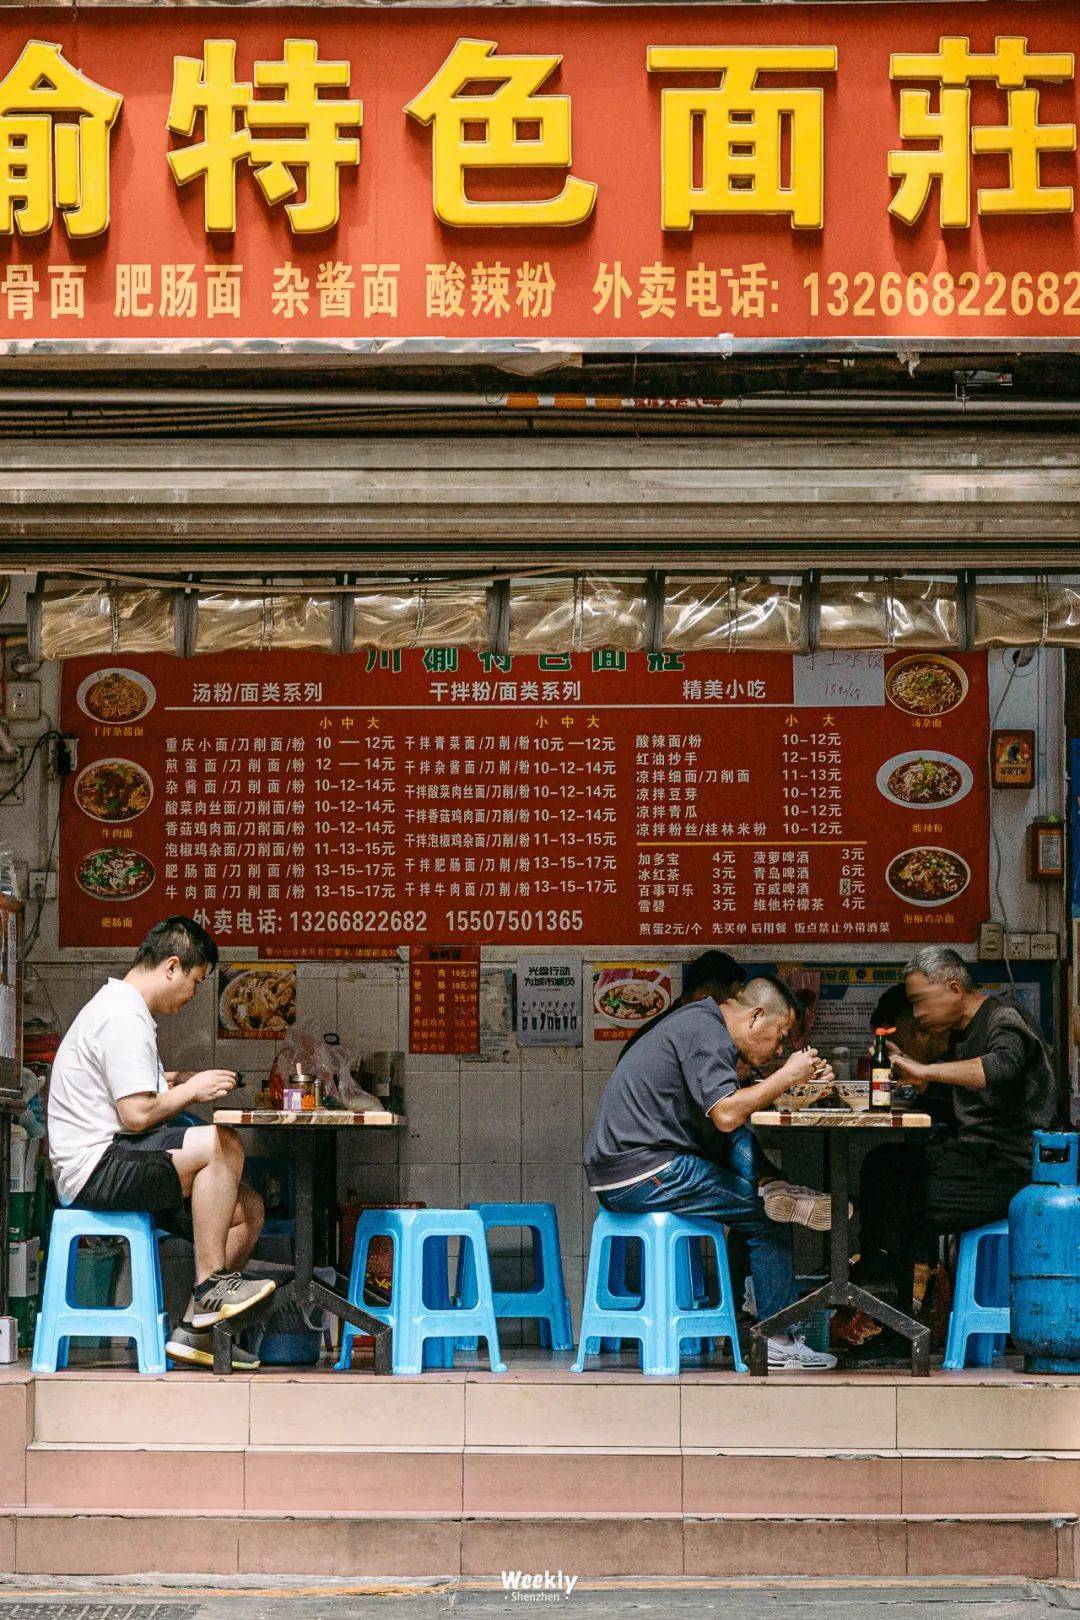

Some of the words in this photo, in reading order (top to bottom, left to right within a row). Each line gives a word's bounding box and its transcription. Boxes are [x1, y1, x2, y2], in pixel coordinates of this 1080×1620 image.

[1, 265, 86, 320] 骨面
[114, 264, 243, 318] 肥肠面
[272, 262, 400, 318] 杂酱面
[426, 262, 555, 318] 酸辣粉
[593, 261, 778, 318] 外卖电话:
[804, 272, 1080, 320] 13266822682
[193, 682, 322, 702] 汤粉/面类系列
[430, 681, 580, 701] 干拌粉/面类系列
[683, 680, 765, 699] 精美小吃
[319, 717, 332, 730] 小
[341, 716, 354, 730] 中
[367, 716, 380, 729] 大
[535, 716, 548, 729] 小
[561, 716, 574, 729] 中
[587, 714, 600, 728] 大
[785, 715, 798, 728] 小
[822, 714, 835, 727] 大
[166, 737, 304, 752] 重庆小面/刀削面/粉
[405, 736, 529, 750] 干拌青菜面/刀削/粉
[636, 735, 700, 748] 酸辣面/粉
[783, 733, 841, 745] 10-12元
[166, 758, 305, 772] 煎蛋面/刀削面/粉
[637, 752, 696, 765] 红油抄手
[783, 751, 841, 763] 12-15元
[405, 760, 529, 774] 干拌杂酱面/刀削/粉
[534, 761, 616, 774] 10-12-14元
[637, 770, 749, 783] 凉拌细面/刀削面
[783, 769, 841, 781] 11-13元
[166, 779, 304, 794] 杂酱面/刀削面/粉
[315, 779, 395, 792] 10-12-14元
[405, 784, 529, 798] 干拌酸菜肉丝面/刀削/粉
[534, 785, 616, 798] 10-12-14元
[637, 788, 697, 801] 凉拌豆芽
[783, 786, 841, 798] 10-12元
[166, 800, 304, 815] 酸菜肉丝面/刀削面/粉
[315, 800, 395, 813] 10-12-14元
[637, 805, 697, 818] 凉拌青瓜
[784, 804, 841, 816] 10-12元
[405, 809, 529, 823] 干拌香菇鸡肉面/刀削/粉
[534, 808, 616, 822] 10-12-14元
[101, 828, 134, 839] 牛肉面
[166, 821, 304, 836] 香菇鸡肉面/刀削面/粉
[315, 821, 395, 834] 10-12-14元
[637, 823, 766, 836] 凉拌粉丝/桂林米粉
[784, 822, 841, 834] 10-12元
[912, 823, 943, 833] 酸辣粉
[405, 833, 530, 848] 干拌泡椒鸡杂面/刀削/粉
[534, 832, 616, 845] 11-13-15元
[166, 842, 304, 857] 泡椒鸡杂面/刀削面/粉
[315, 842, 395, 855] 11-13-15元
[754, 851, 808, 864] 菠萝啤酒
[842, 848, 864, 860] 3元
[406, 857, 530, 872] 干拌肥肠面/刀削/粉
[535, 856, 616, 869] 13-15-17元
[639, 853, 678, 865] 加多宝
[713, 851, 735, 863] 4元
[166, 864, 304, 878] 肥肠面/刀削面/粉
[315, 863, 395, 876] 13-15-17元
[639, 868, 679, 880] 冰红茶
[713, 867, 735, 879] 3元
[755, 867, 808, 879] 青岛啤酒
[842, 865, 864, 876] 6元
[166, 885, 305, 899] 牛肉面/刀削面/粉
[315, 884, 395, 898] 13-15-17元
[405, 882, 530, 896] 干拌牛肉面/刀削/粉
[535, 880, 616, 893] 13-15-17元
[639, 884, 693, 896] 百事可乐
[713, 883, 735, 895] 3元
[756, 883, 808, 895] 百威啤酒
[639, 900, 664, 912] 雪碧
[714, 899, 735, 911] 3元
[754, 898, 823, 911] 维他柠檬茶
[842, 894, 865, 909] 4元
[101, 917, 133, 928] 肥肠面
[193, 908, 283, 934] 外卖电话:
[291, 911, 426, 931] 13266822682
[446, 910, 582, 931] 15507501365
[640, 923, 701, 935] 煎蛋2元/个
[713, 923, 746, 933] 先买单
[752, 923, 786, 933] 后用餐
[795, 922, 889, 933] 饭点禁止外带酒菜
[528, 966, 571, 976] 光盘行动
